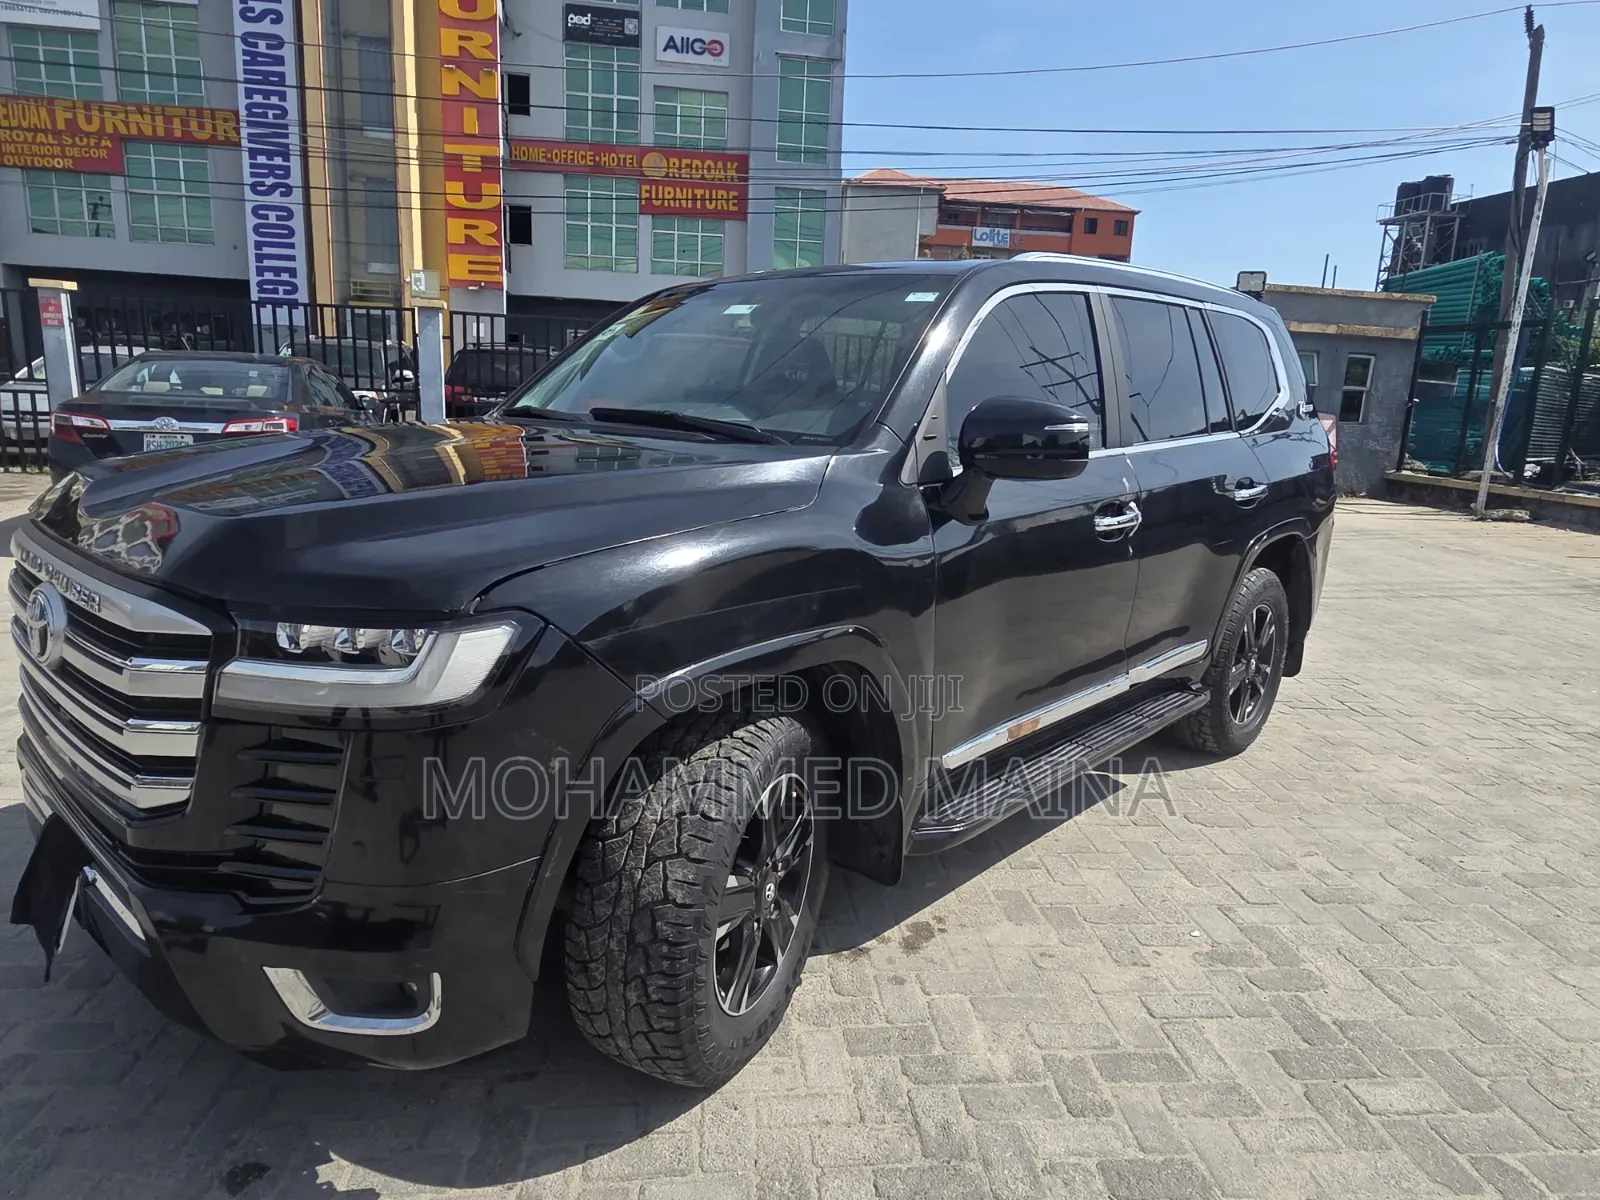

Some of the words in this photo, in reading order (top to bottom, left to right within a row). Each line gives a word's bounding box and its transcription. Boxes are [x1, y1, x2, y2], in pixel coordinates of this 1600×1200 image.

[240, 31, 293, 197] CAREGIVERS
[0, 129, 59, 144] ROYAL
[61, 133, 112, 148] SOFA
[2, 143, 62, 156] INTERIOR
[65, 147, 108, 159] DECOR
[3, 155, 74, 169] OUTDOOR
[511, 146, 546, 162] HOME
[552, 149, 594, 166] OFFICE
[601, 152, 639, 167] HOTEL
[669, 157, 739, 182] REDOAK
[641, 185, 739, 211] FURNITURE
[250, 204, 300, 310] COLLEGE
